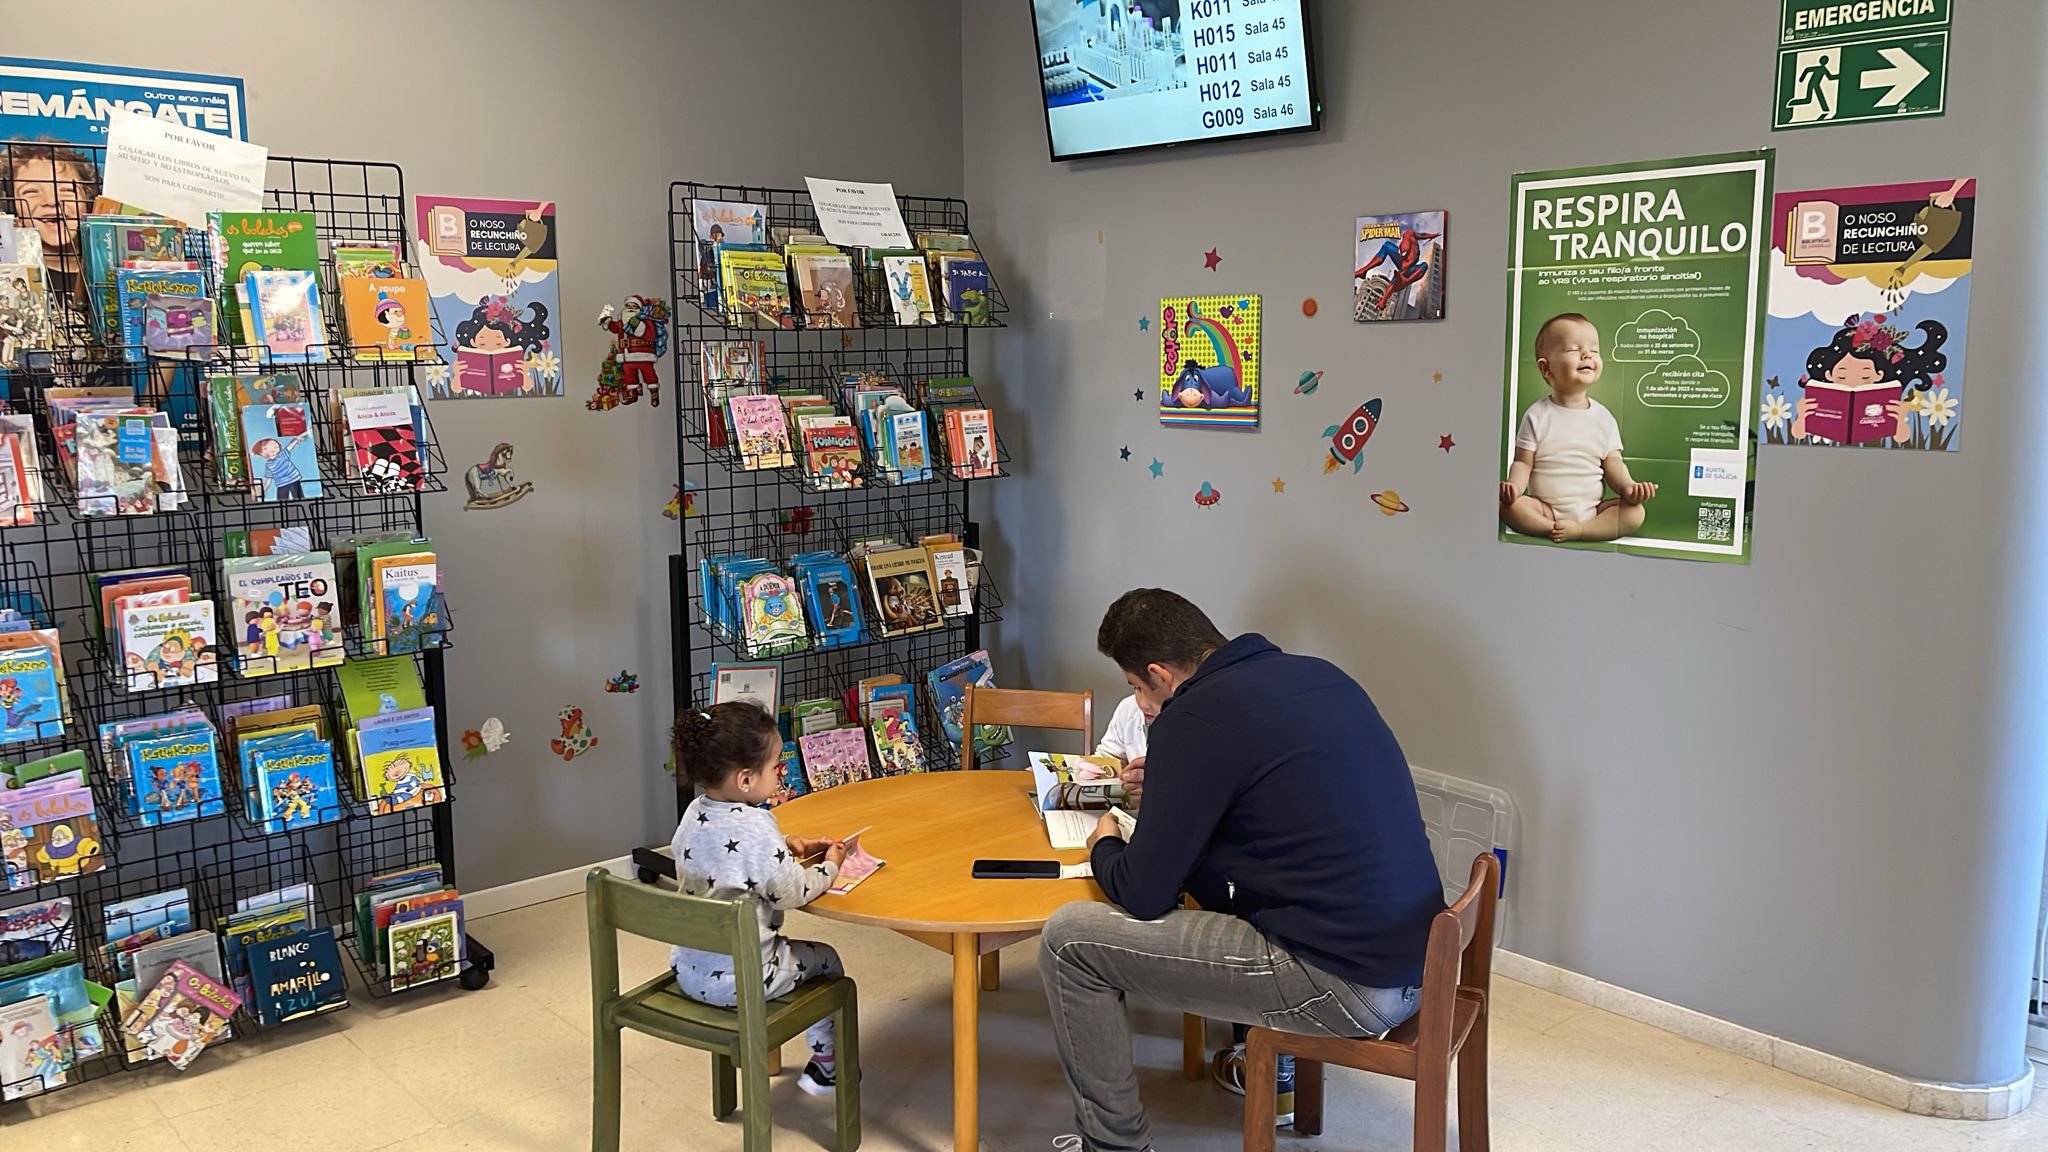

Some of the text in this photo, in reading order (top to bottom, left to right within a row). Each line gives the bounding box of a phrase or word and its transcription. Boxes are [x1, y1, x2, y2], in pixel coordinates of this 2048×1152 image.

[1191, 0, 1231, 20] K011
[1795, 0, 1935, 31] EMERGENCIA
[1193, 17, 1286, 48] H015 Sala 45
[1197, 47, 1289, 75] H011 Sala 45
[144, 91, 176, 101] Outro
[178, 95, 199, 103] ano
[1200, 75, 1291, 102] H012 Sala 45
[1202, 103, 1294, 129] G009 Sala 46
[164, 132, 216, 151] POR FAVOR
[1532, 189, 1686, 231] RESPIRA
[1844, 212, 1897, 226] O NOSO
[440, 213, 458, 237] B
[469, 219, 506, 229] O NOSO
[1802, 211, 1826, 240] B
[1843, 222, 1929, 240] RECUNCHIÑO
[470, 229, 528, 241] RECUNCHIÑO
[1548, 222, 1747, 260] TRANQUILO
[471, 242, 521, 252] DE LECTURA
[1842, 240, 1916, 255] DE LECTURA
[1602, 273, 1658, 283] respiratorio
[1634, 265, 1665, 273] fronte
[368, 283, 377, 293] A
[1647, 333, 1674, 341] hospital
[1662, 370, 1690, 378] recibirán
[238, 579, 248, 587] EL
[303, 571, 313, 580] DE
[385, 568, 419, 579] Kaitus
[278, 578, 328, 601] TEO
[269, 942, 310, 962] BLANCO
[270, 971, 331, 997] AMARILLO
